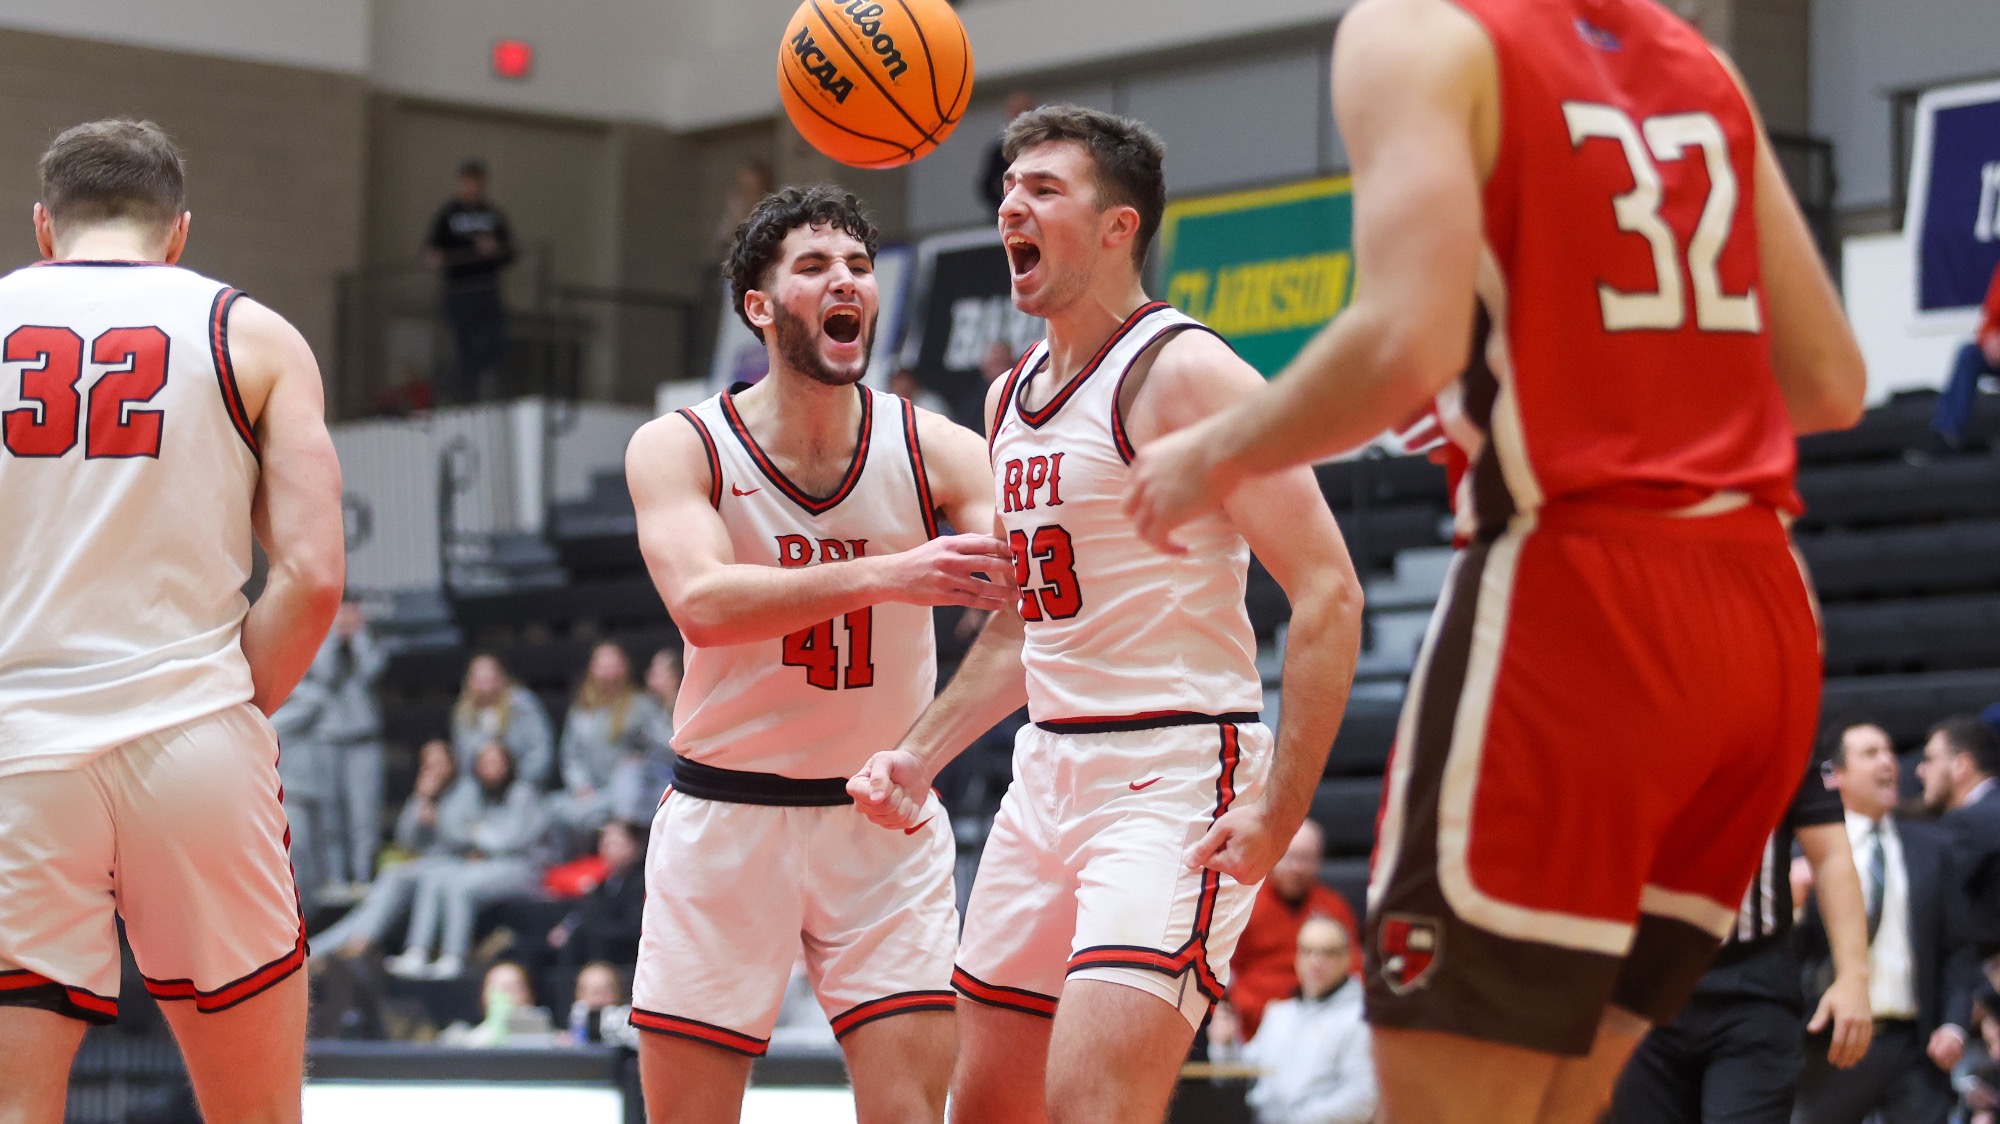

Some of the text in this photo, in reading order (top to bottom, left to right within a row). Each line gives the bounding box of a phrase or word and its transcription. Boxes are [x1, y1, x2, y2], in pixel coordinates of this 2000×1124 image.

[791, 26, 855, 105] NCAA
[832, 0, 908, 81] ilson
[1562, 101, 1760, 333] 32
[2, 325, 171, 460] 32
[1003, 452, 1065, 513] RPI
[782, 605, 874, 690] 41
